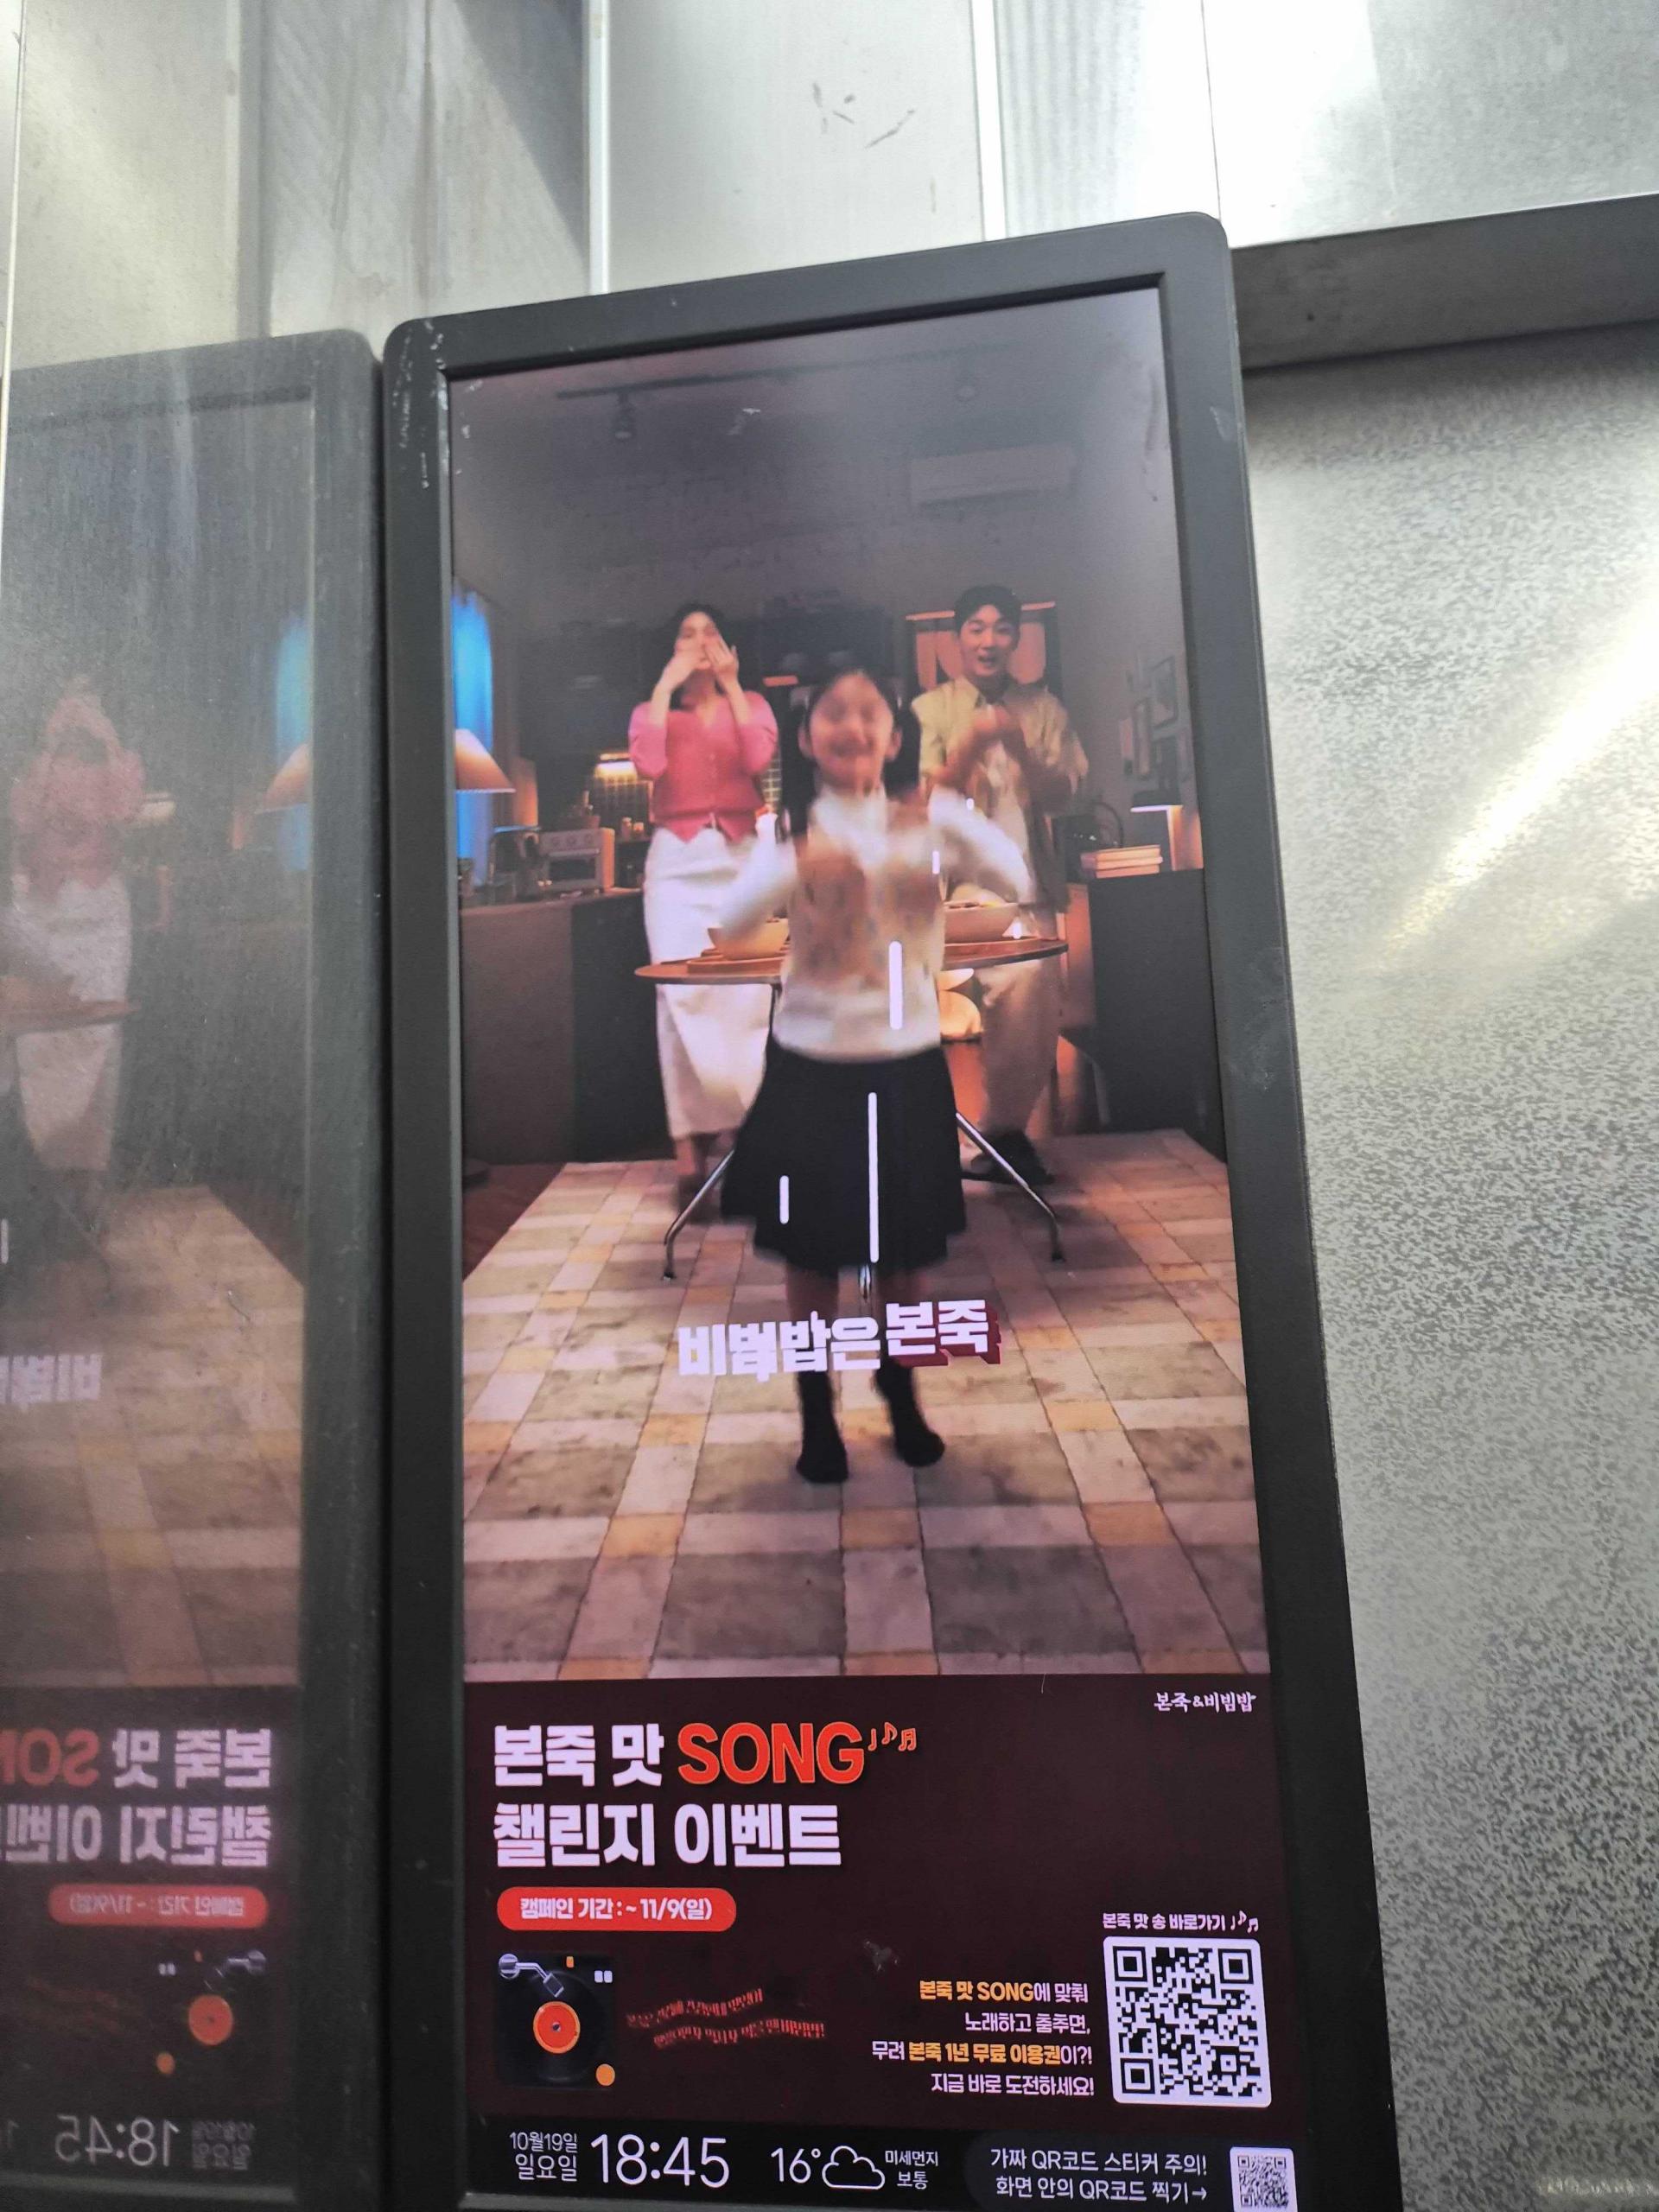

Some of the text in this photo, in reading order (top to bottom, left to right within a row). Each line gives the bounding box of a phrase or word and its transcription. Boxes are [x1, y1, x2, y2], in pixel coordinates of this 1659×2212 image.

[885, 1299, 989, 1357] 본죽
[494, 1721, 865, 1787] 본죽 맛 SONG
[493, 1802, 842, 1868] 챌린지 이벤트
[520, 1897, 574, 1919] 캠페인
[1103, 1912, 1225, 1931] 본죽 맛 송 바로가기
[919, 1980, 1089, 2003] 본죽 맛 SONG에 맞춰
[964, 2012, 1090, 2035] 노래하고 춤추면,
[872, 2041, 1093, 2066] 무려 본죽 1년 무료 이용권이?!
[931, 2072, 1095, 2096] 지금 바로 도전하세요!
[515, 2154, 578, 2182] 일요일
[590, 2133, 730, 2189] 18:45
[771, 2147, 822, 2184] 16°
[885, 2150, 939, 2167] 미세먼지
[990, 2148, 1207, 2177] 가짜 QR코드 스티커 주의!
[897, 2171, 929, 2190] 보통
[996, 2176, 1189, 2204] 화면 안의 QR코드 찍기
